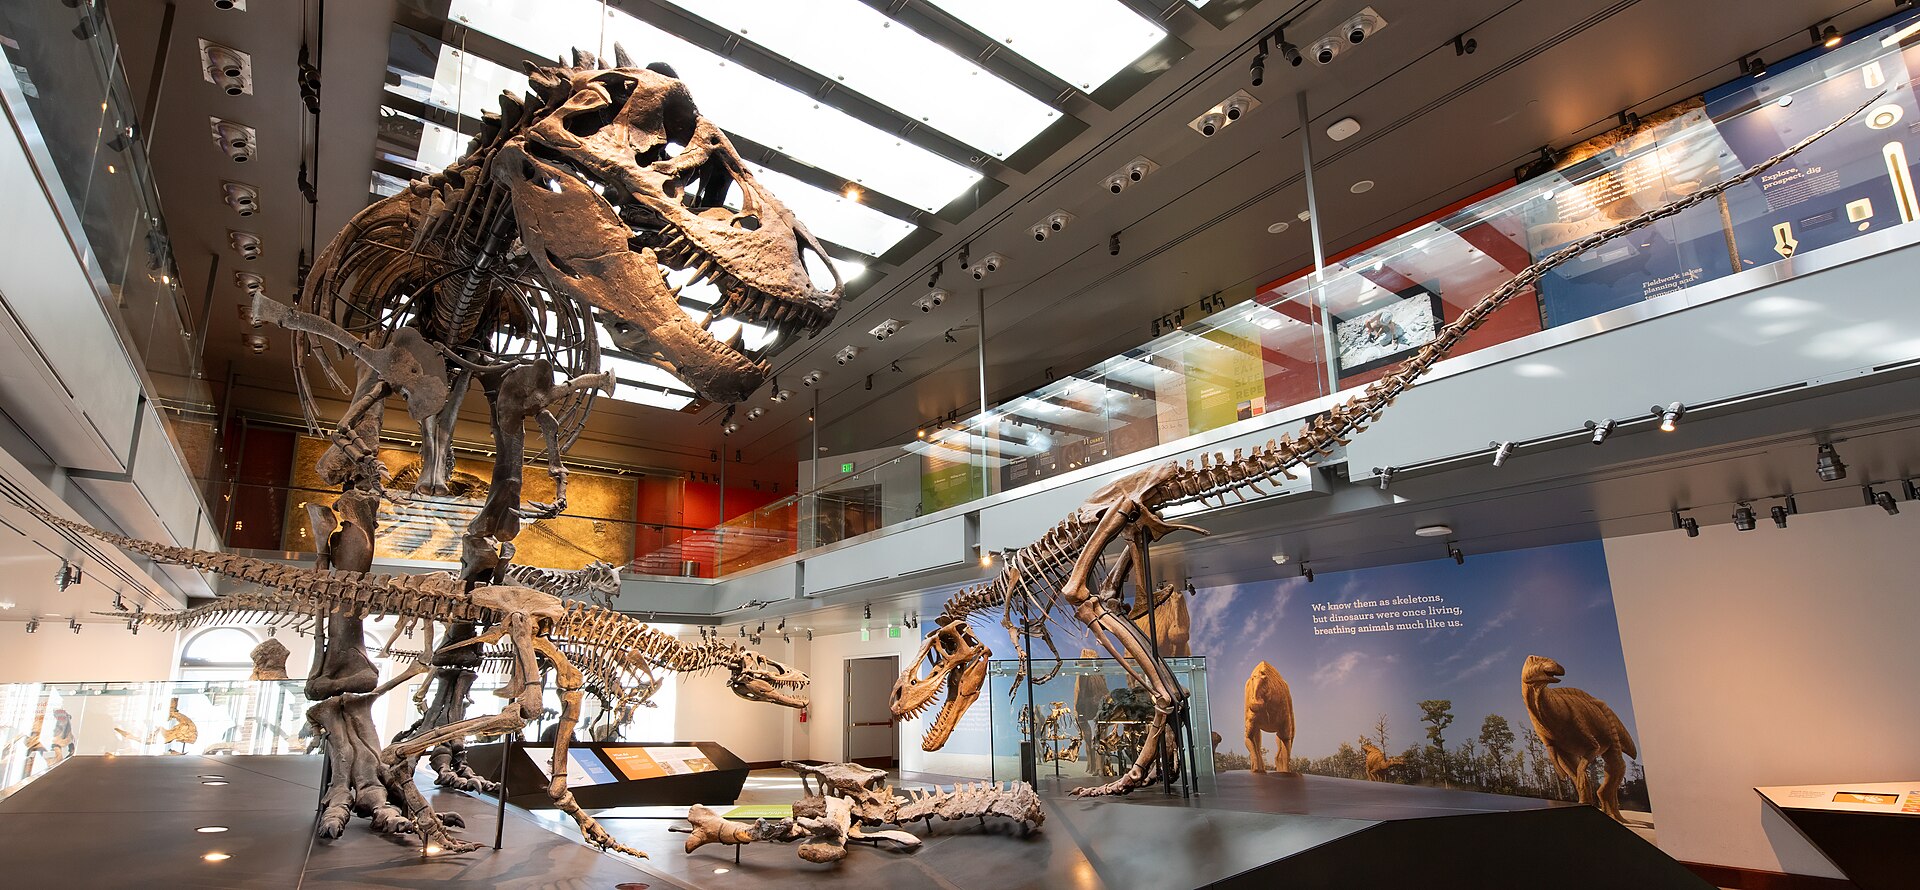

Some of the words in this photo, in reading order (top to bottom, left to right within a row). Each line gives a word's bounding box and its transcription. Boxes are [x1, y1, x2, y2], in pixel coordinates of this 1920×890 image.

[1761, 168, 1798, 183] Explore,
[1762, 173, 1805, 190] prospect,
[1806, 166, 1822, 176] dig
[1642, 273, 1681, 288] Fieldwork
[1681, 267, 1703, 278] takes
[1643, 282, 1678, 296] planning
[1678, 276, 1695, 285] and
[1311, 603, 1326, 612] We
[1327, 602, 1352, 611] know
[1353, 599, 1377, 609] them
[1392, 594, 1444, 606] skeletons,
[1312, 614, 1328, 624] but
[1329, 613, 1374, 622] dinosaurs
[1376, 611, 1400, 619] were
[1402, 608, 1427, 618] once
[1428, 606, 1463, 616] living,
[1314, 625, 1356, 636] breathing
[1357, 622, 1394, 632] animals
[1396, 620, 1424, 630] much
[1426, 618, 1446, 628] like
[1446, 620, 1464, 628] us.
